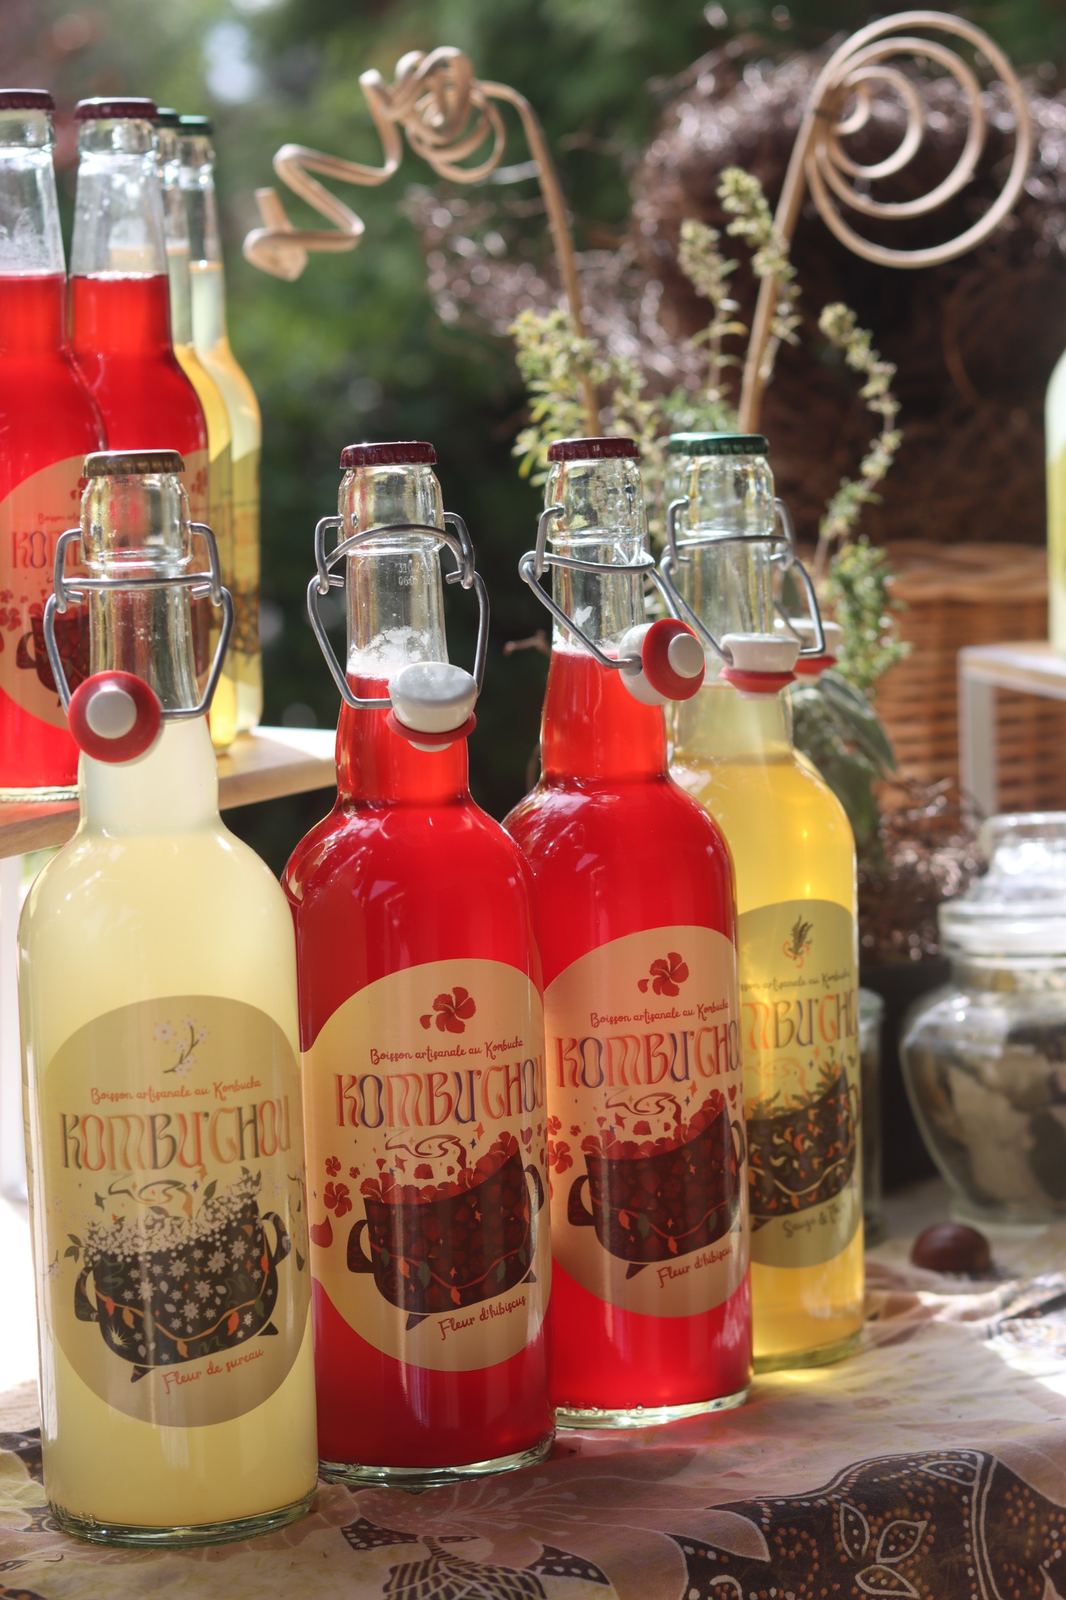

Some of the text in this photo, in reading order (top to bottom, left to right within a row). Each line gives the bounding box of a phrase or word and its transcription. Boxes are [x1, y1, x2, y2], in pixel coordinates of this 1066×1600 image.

[589, 1011, 632, 1028] Boisson
[633, 1007, 681, 1024] artisanale
[682, 1009, 695, 1017] au
[369, 1035, 524, 1065] Boisson artisanale au Kombucha
[90, 1075, 262, 1105] Boisson artisanale au Kombucha
[656, 1265, 691, 1289] Fleur
[437, 1295, 527, 1341] Fleur d'hibiscus
[162, 1347, 265, 1395] Fleur de sureau
